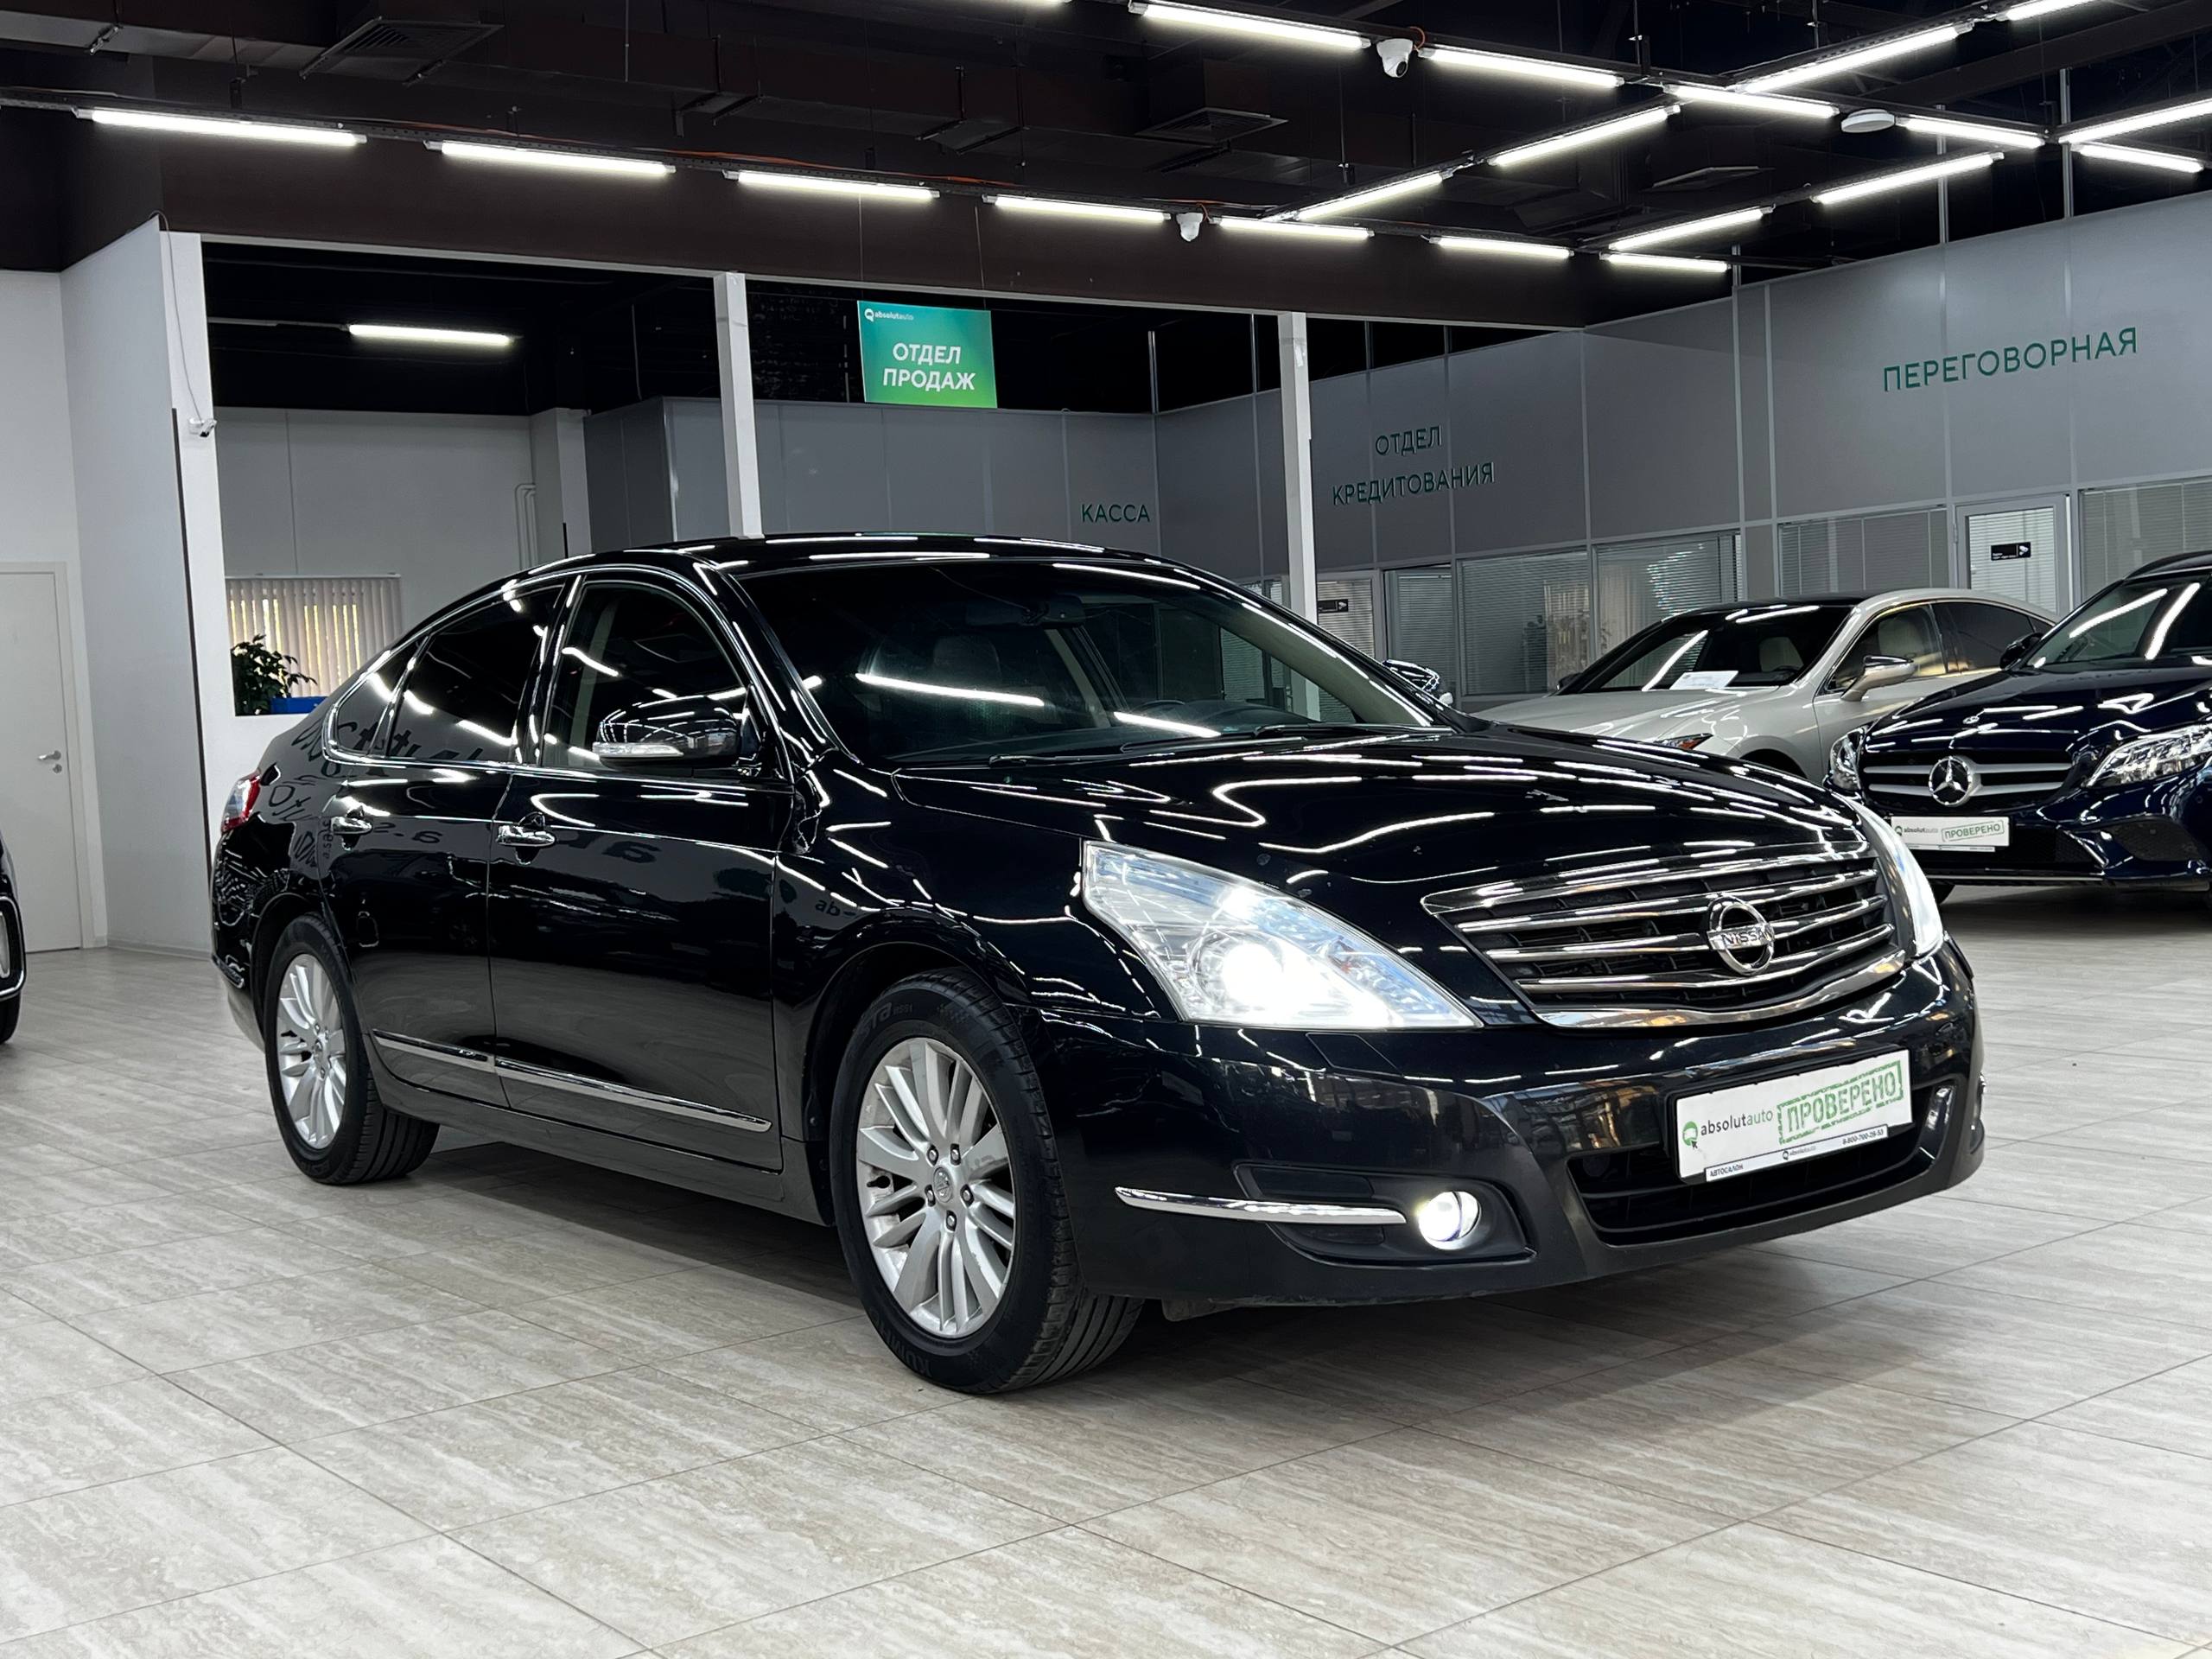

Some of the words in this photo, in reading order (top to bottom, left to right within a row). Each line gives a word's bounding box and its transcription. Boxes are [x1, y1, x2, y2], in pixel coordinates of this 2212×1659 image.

[893, 342, 961, 365] ОТДЕЛ
[1884, 327, 2137, 392] ПЕРЕГОВОРНАЯ
[882, 368, 976, 391] ПРОДАЖ
[1376, 425, 1442, 456] ОТДЕЛ
[1332, 461, 1495, 505] КРЕДИТОВАНИЯ
[1081, 503, 1151, 523] КАССА
[1944, 823, 2000, 839] ПРОВЕРЕНО
[1786, 1070, 1897, 1134] ПРОВЕРЕНО
[1700, 1109, 1774, 1136] absolutauto
